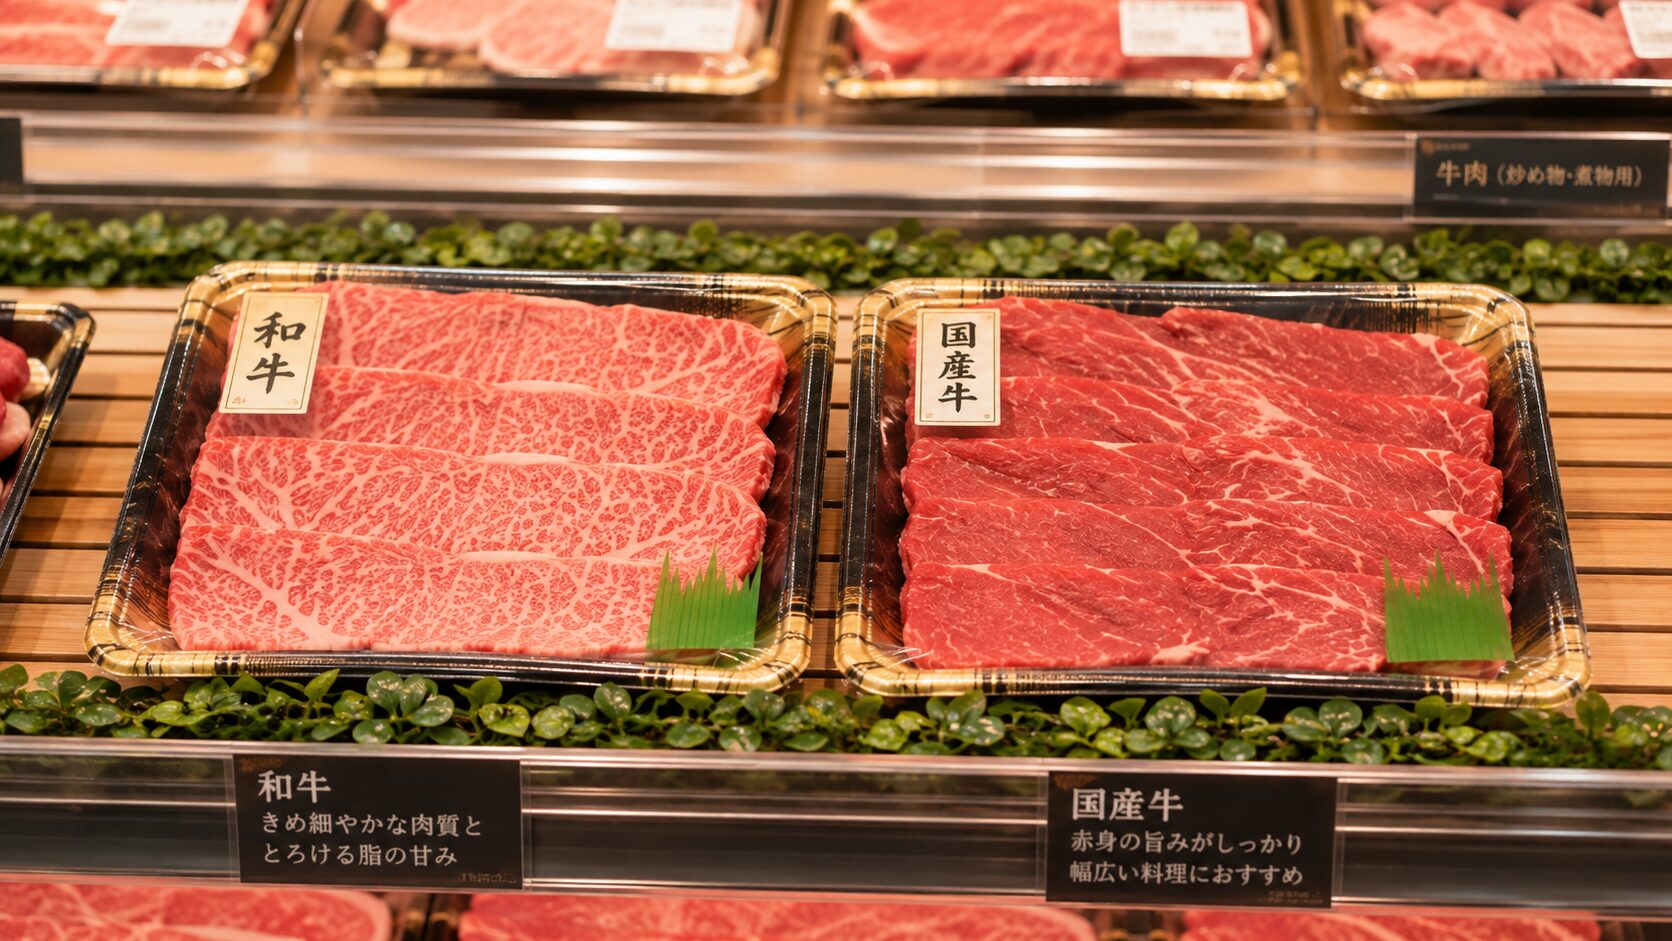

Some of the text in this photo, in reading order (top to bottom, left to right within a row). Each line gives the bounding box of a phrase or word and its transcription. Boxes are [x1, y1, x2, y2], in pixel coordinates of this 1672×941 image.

[246, 311, 307, 395] 和牛
[938, 321, 978, 413] 国産牛
[257, 769, 332, 804] 和牛
[1071, 787, 1184, 822] 国産牛
[262, 811, 482, 838] きめ細やかな肉質と
[264, 843, 458, 867] とろける脂の甘み
[1070, 828, 1302, 856] 赤身の旨みがしっかり
[1069, 860, 1304, 886] 幅広い料理におすすめ
